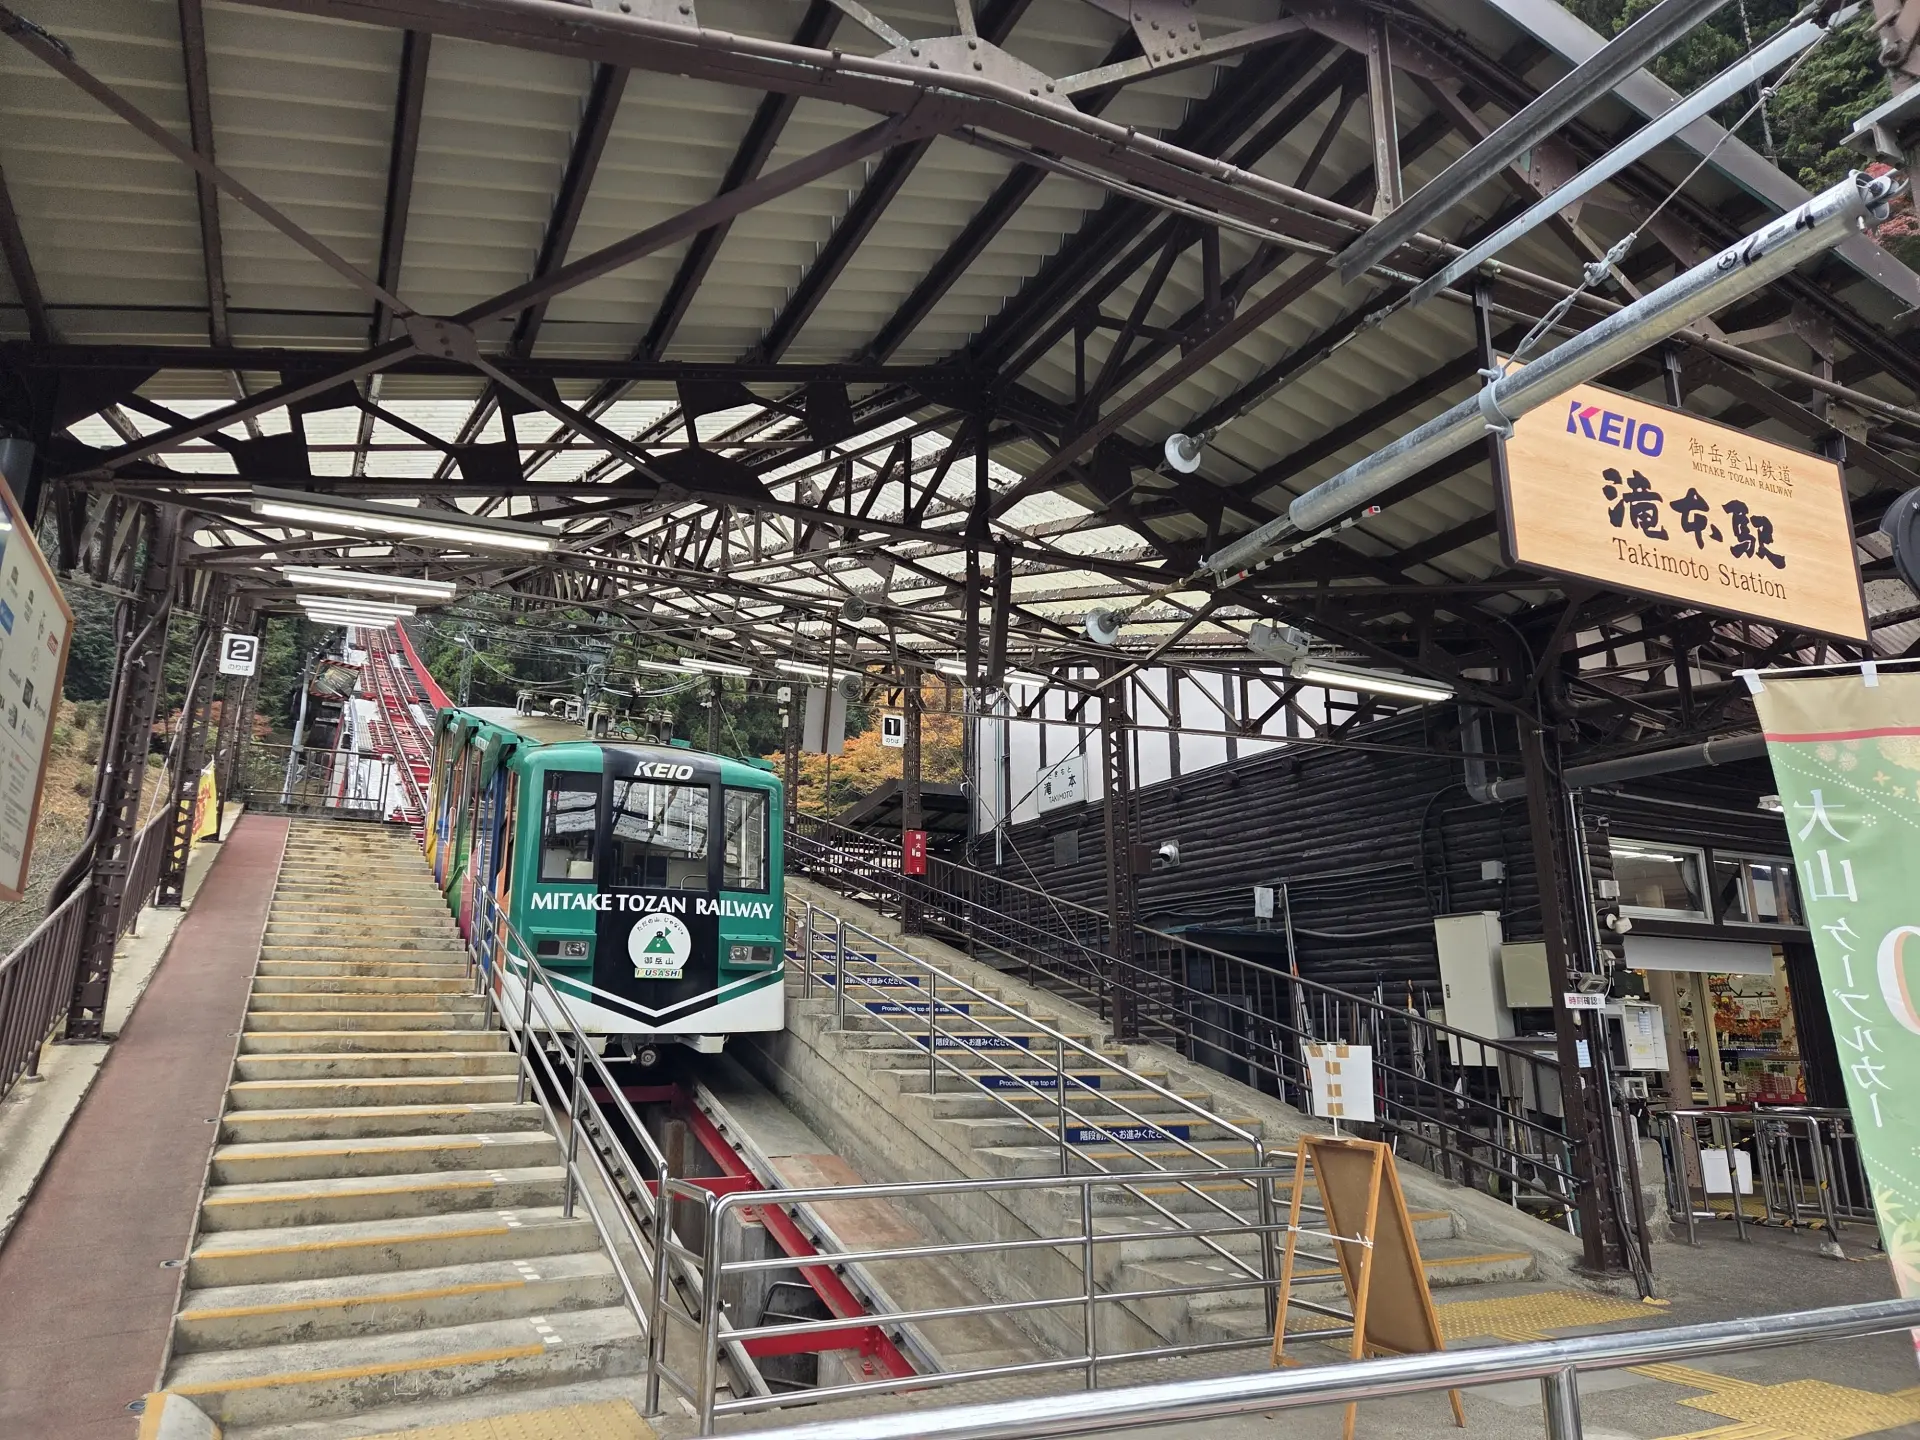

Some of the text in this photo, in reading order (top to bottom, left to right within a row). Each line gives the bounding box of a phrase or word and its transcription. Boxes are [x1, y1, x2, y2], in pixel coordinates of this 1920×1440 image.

[1566, 400, 1665, 458] KEIO
[1688, 436, 1794, 487] 御岳登山鉄道
[1692, 460, 1794, 499] MITAKE TOZAN RAILWAY
[1602, 467, 1787, 570] 滝本駅
[1612, 536, 1787, 600] Takimoto Station
[230, 640, 251, 661] 2
[227, 663, 250, 672] のりば
[888, 718, 895, 735] 1
[633, 761, 694, 780] KEIO
[1048, 789, 1074, 803] TAKIMOTO
[530, 892, 774, 920] MITAKE TOZAN RAILWAY
